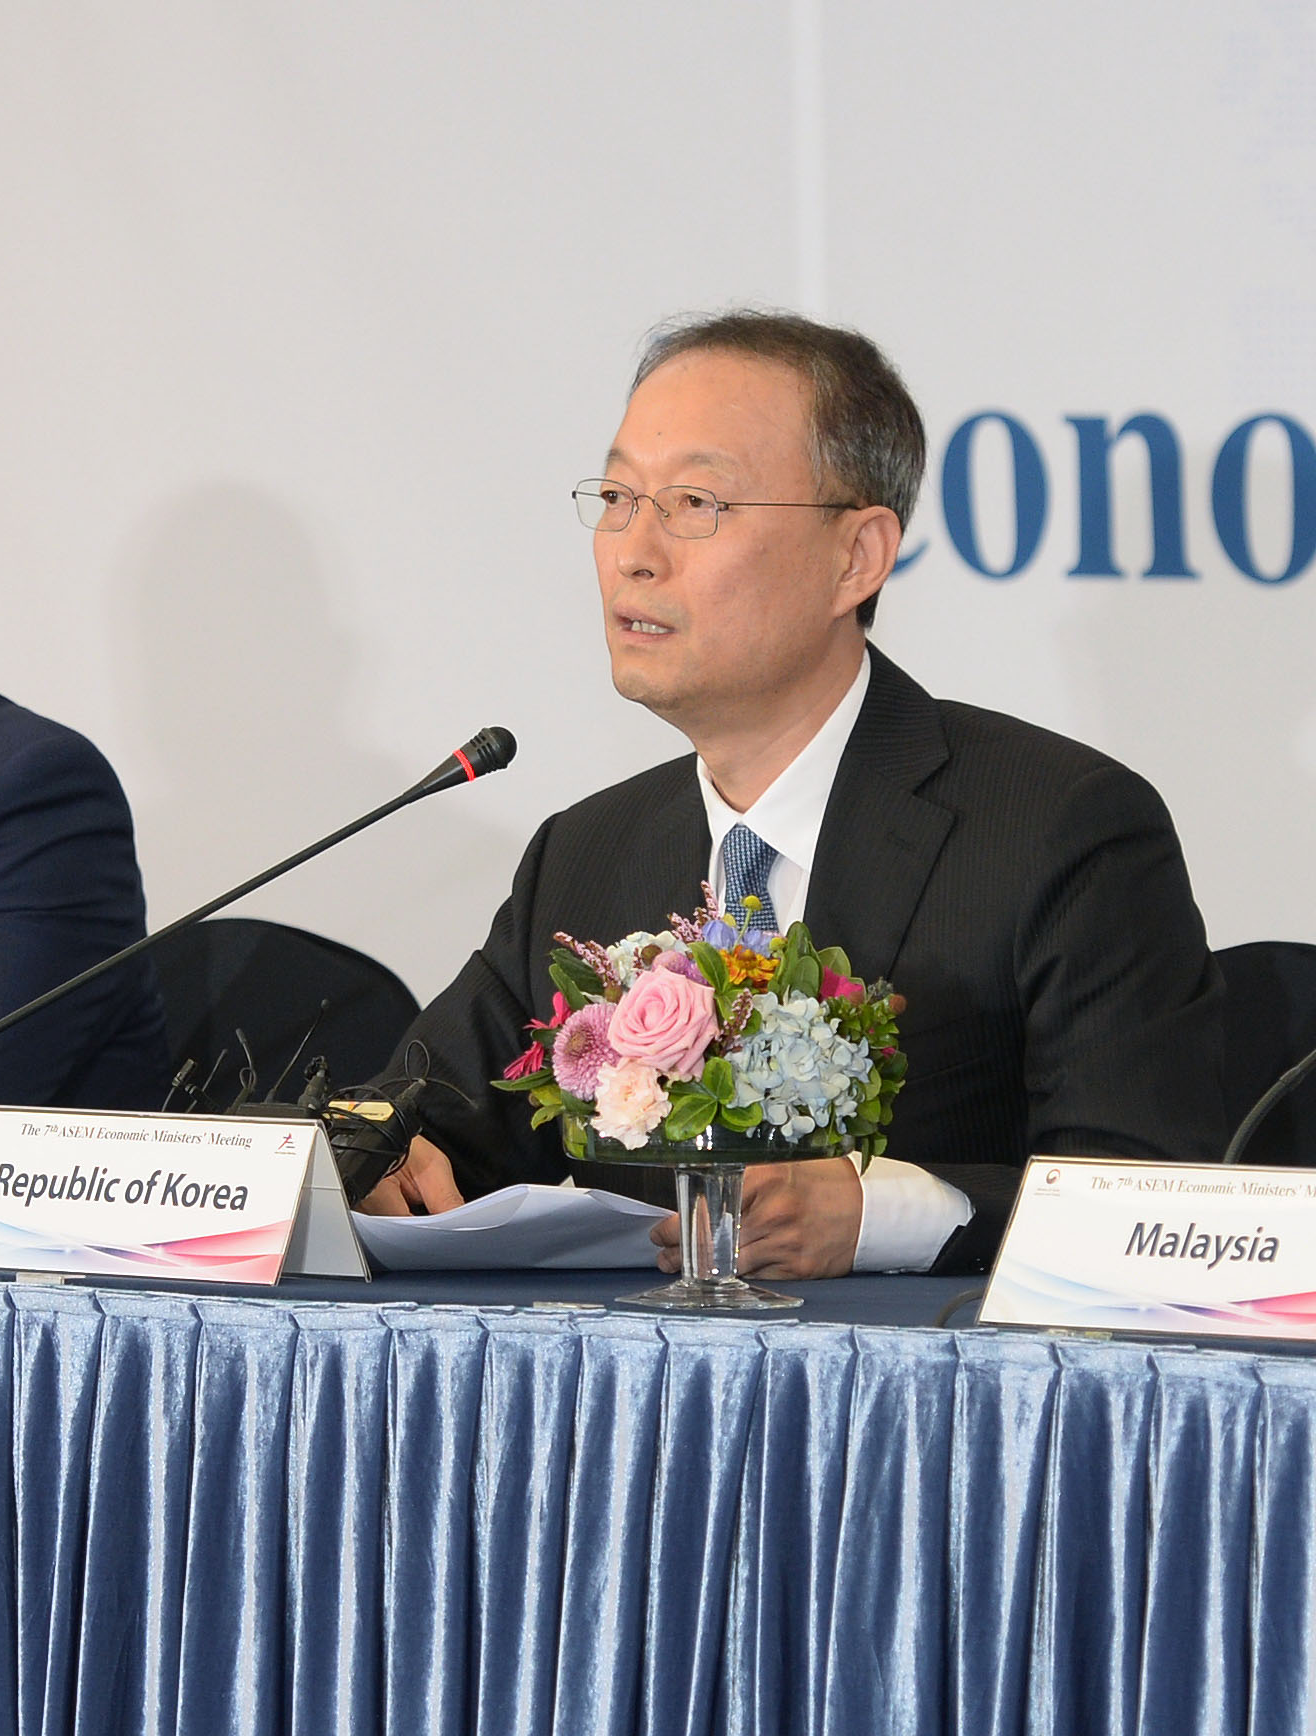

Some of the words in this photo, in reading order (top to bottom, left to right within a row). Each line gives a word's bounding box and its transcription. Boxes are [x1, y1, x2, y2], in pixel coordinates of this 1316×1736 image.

[21, 1123, 41, 1136] The
[58, 1126, 95, 1139] ASEM
[96, 1127, 150, 1141] Economic
[208, 1132, 253, 1149] Meeting
[124, 1169, 163, 1205] of
[162, 1172, 249, 1211] Korea
[1091, 1176, 1113, 1190] The
[1134, 1178, 1175, 1193] ASEM
[1177, 1180, 1237, 1195] Economic
[1124, 1222, 1280, 1270] Malaysia
